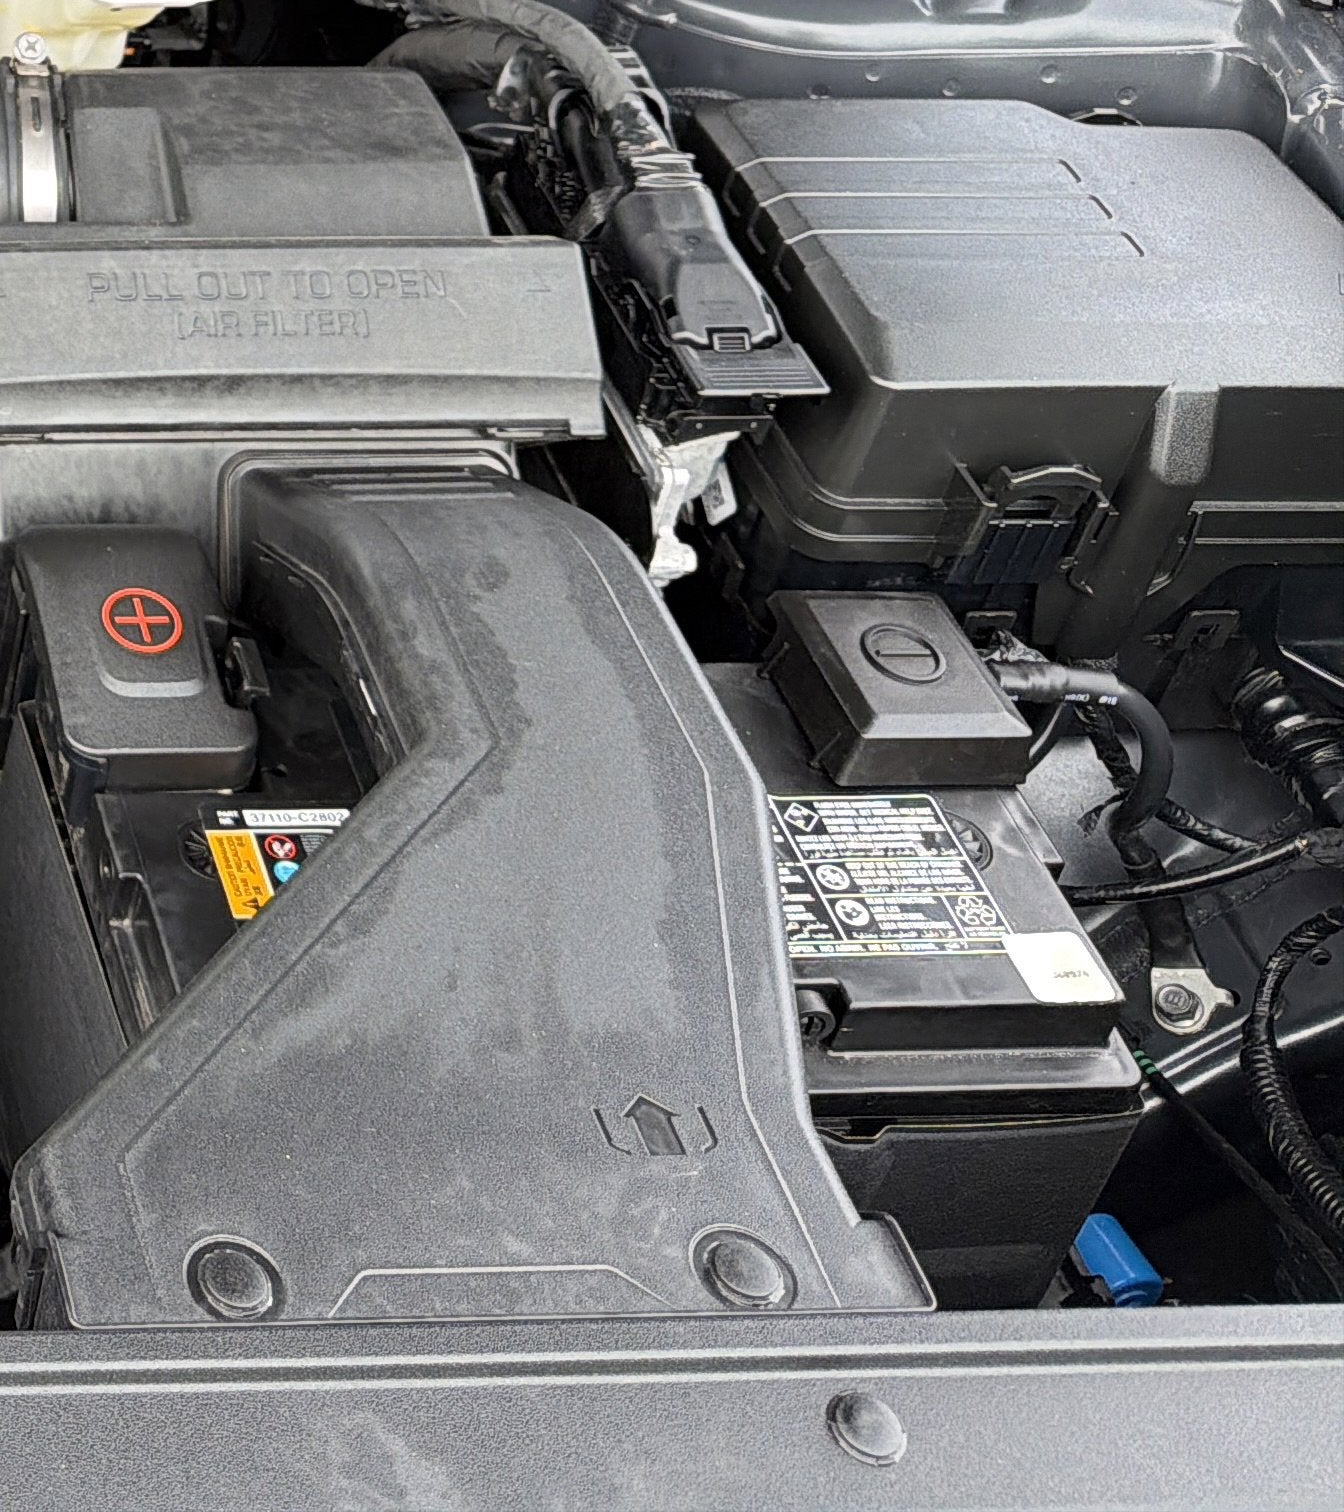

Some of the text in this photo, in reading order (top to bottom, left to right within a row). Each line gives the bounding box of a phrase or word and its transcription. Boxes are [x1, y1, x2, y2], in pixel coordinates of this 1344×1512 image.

[87, 269, 449, 302] PULL OUT TO OPEN
